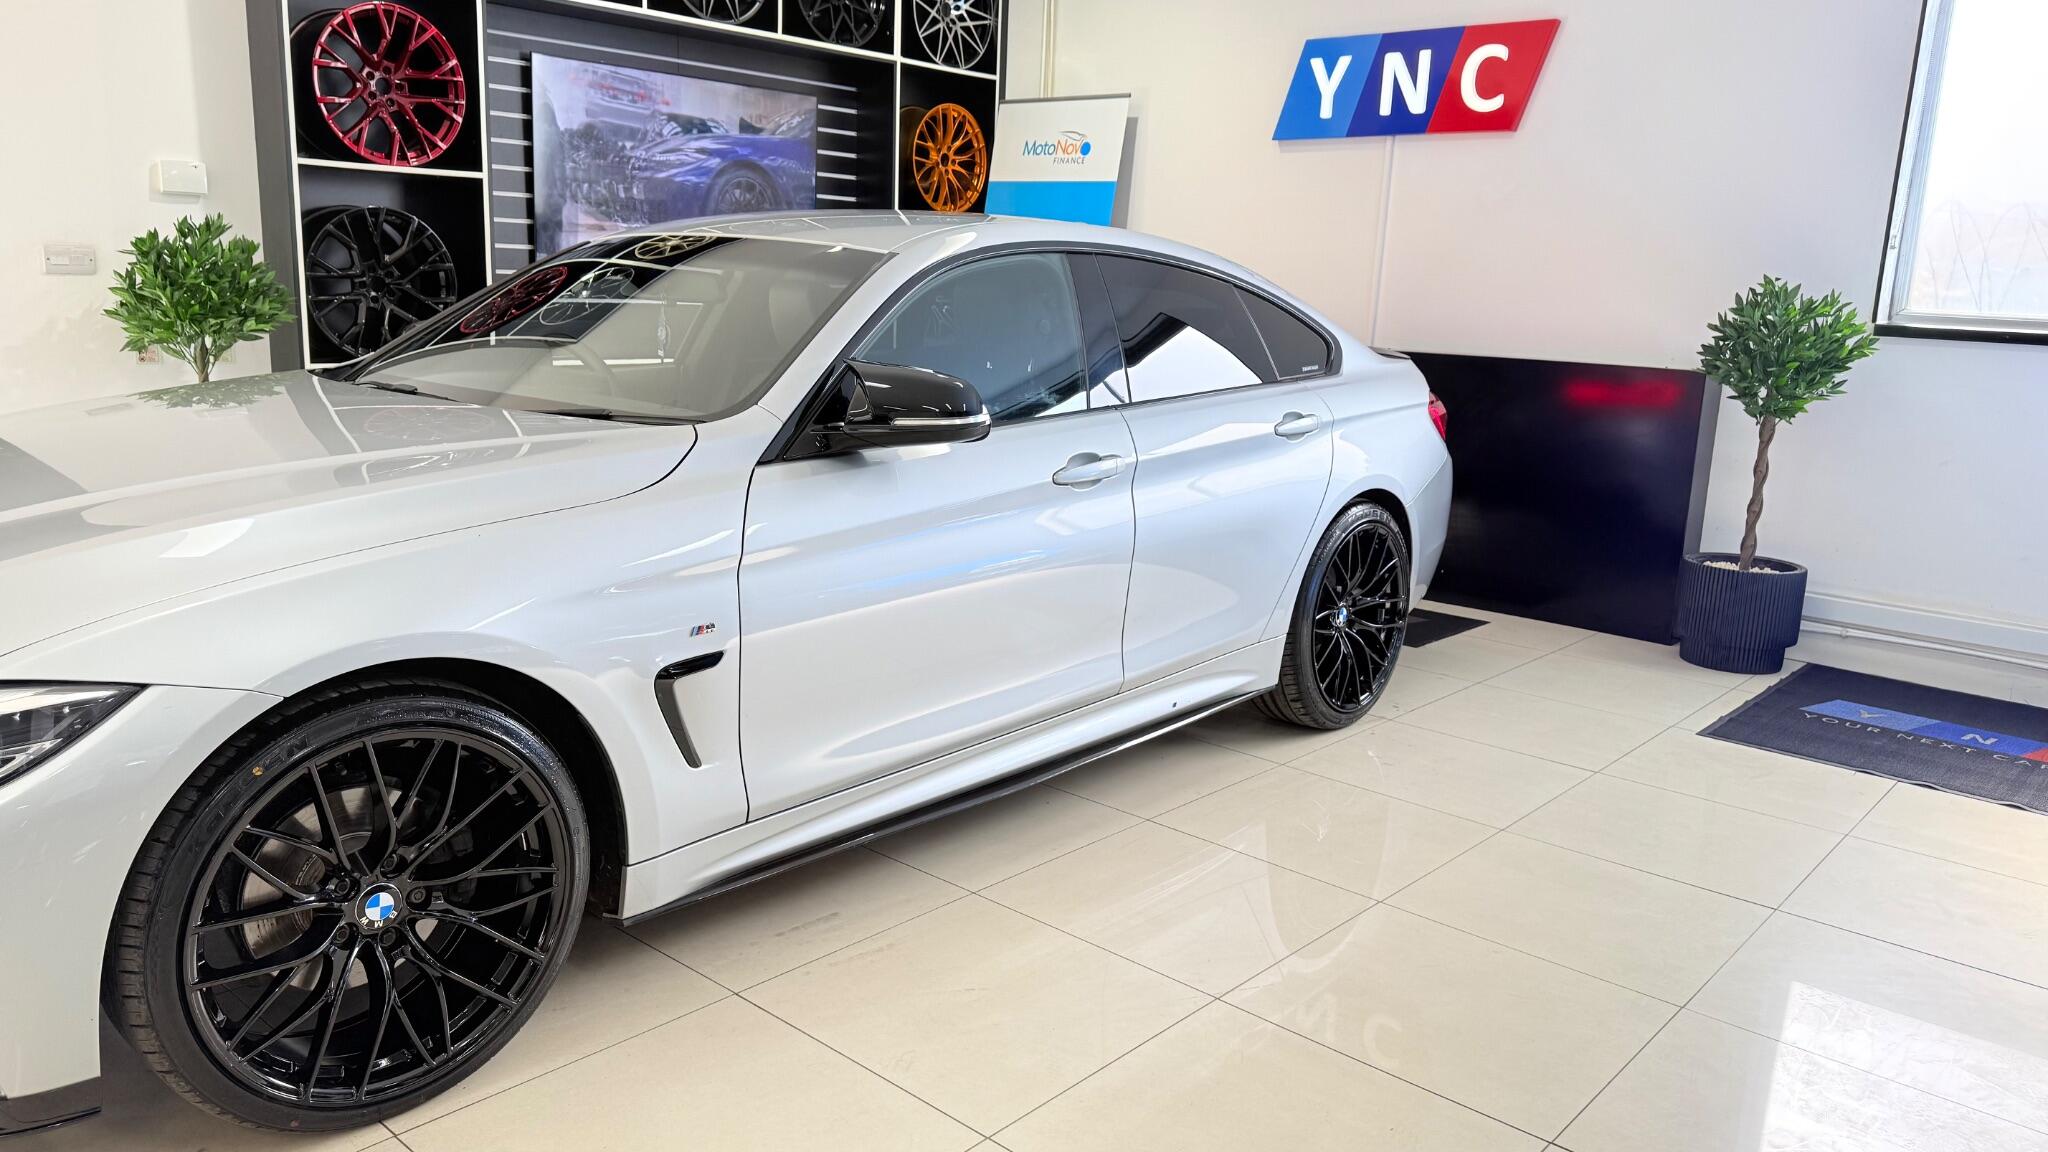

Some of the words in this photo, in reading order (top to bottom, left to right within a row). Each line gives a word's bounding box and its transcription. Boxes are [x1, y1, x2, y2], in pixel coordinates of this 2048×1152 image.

[1309, 43, 1509, 120] YNC
[1022, 138, 1092, 157] MotoNovo
[1052, 156, 1086, 165] FINANCE
[1804, 712, 1882, 734] YOUR
[1896, 732, 1977, 753] NEXT
